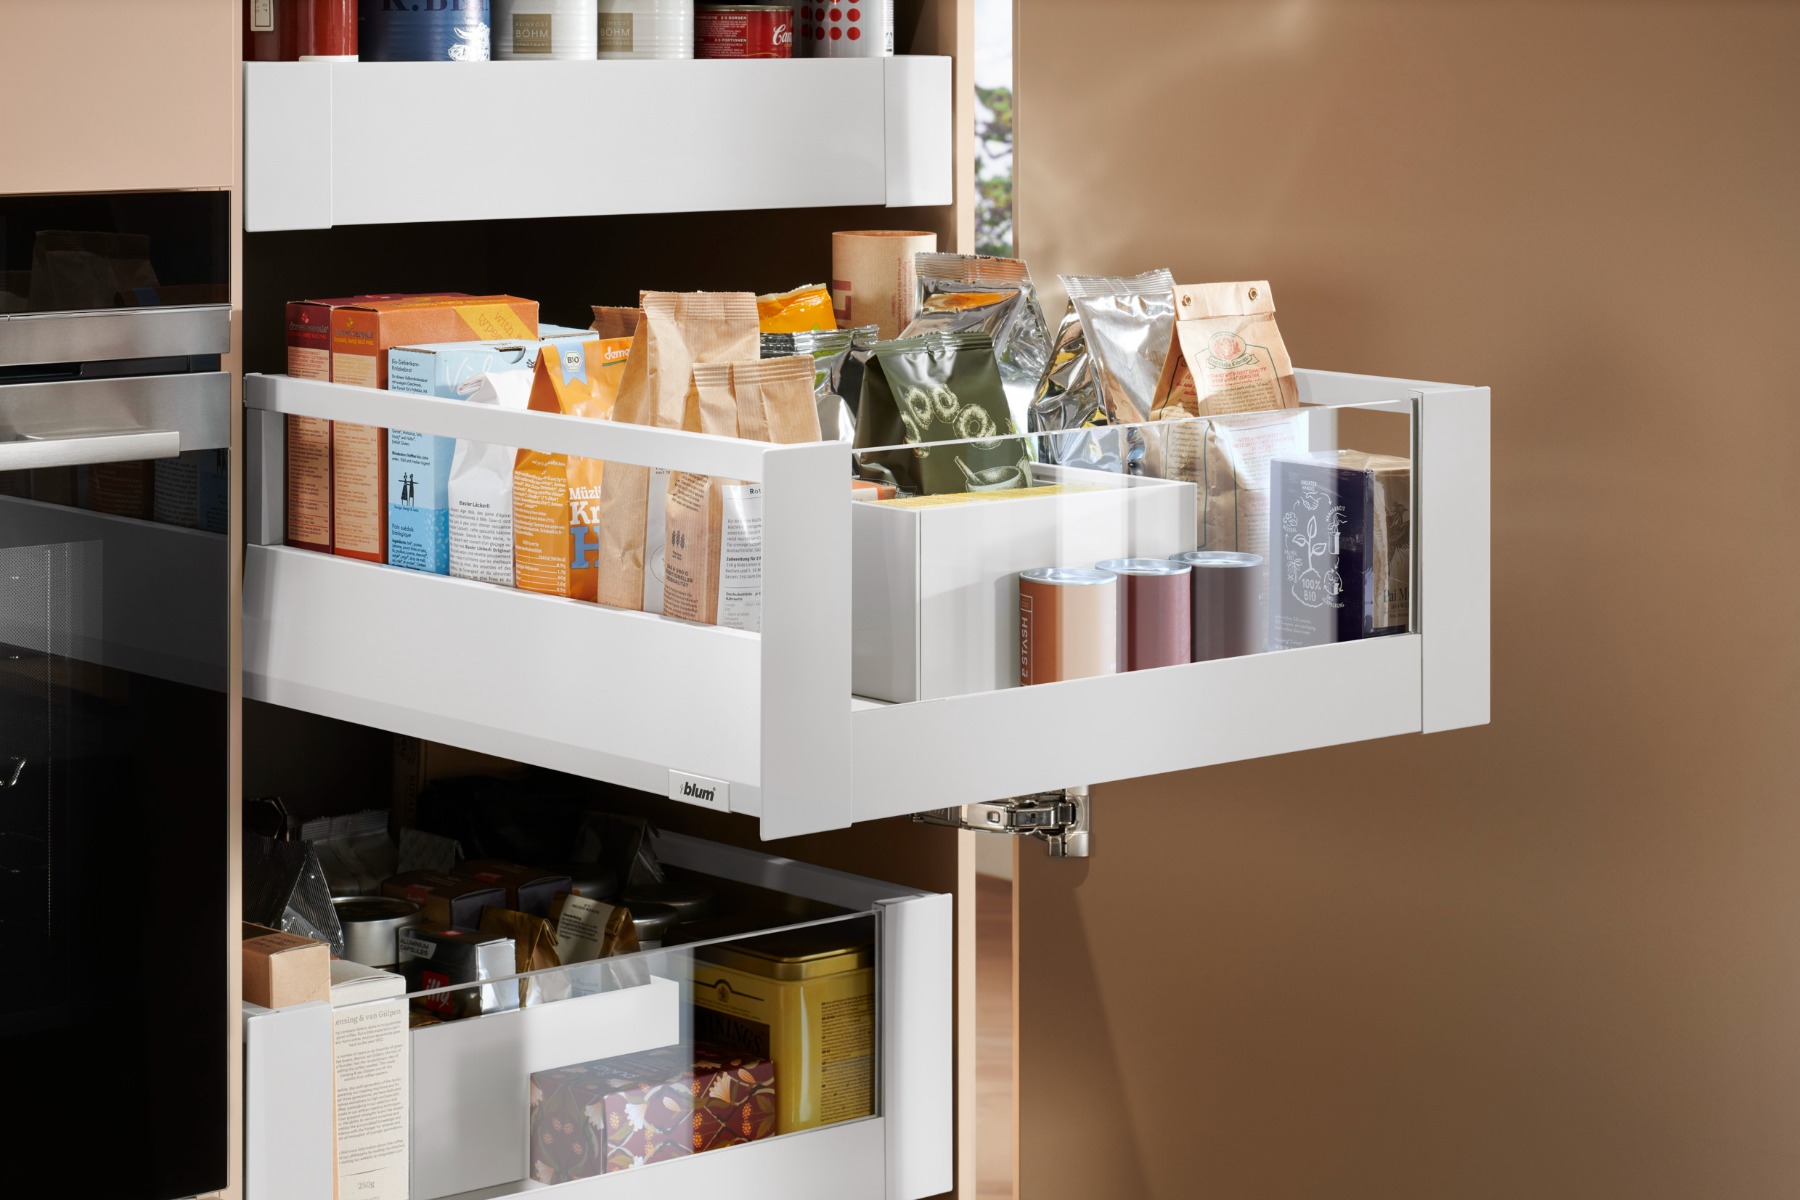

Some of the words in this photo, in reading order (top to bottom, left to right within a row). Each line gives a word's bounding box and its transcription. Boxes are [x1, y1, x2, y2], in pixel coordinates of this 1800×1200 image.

[516, 28, 548, 38] BÖHM
[600, 28, 630, 36] BÖHM
[494, 312, 514, 338] with
[569, 486, 601, 500] Müzli
[1302, 579, 1321, 590] 100%
[1304, 590, 1316, 601] BIO
[684, 782, 714, 801] blum
[400, 944, 428, 956] CAPSULES
[426, 978, 451, 1008] illy
[336, 1016, 358, 1026] ensing
[378, 1009, 400, 1019] Gülpen
[358, 1181, 375, 1190] 250g
